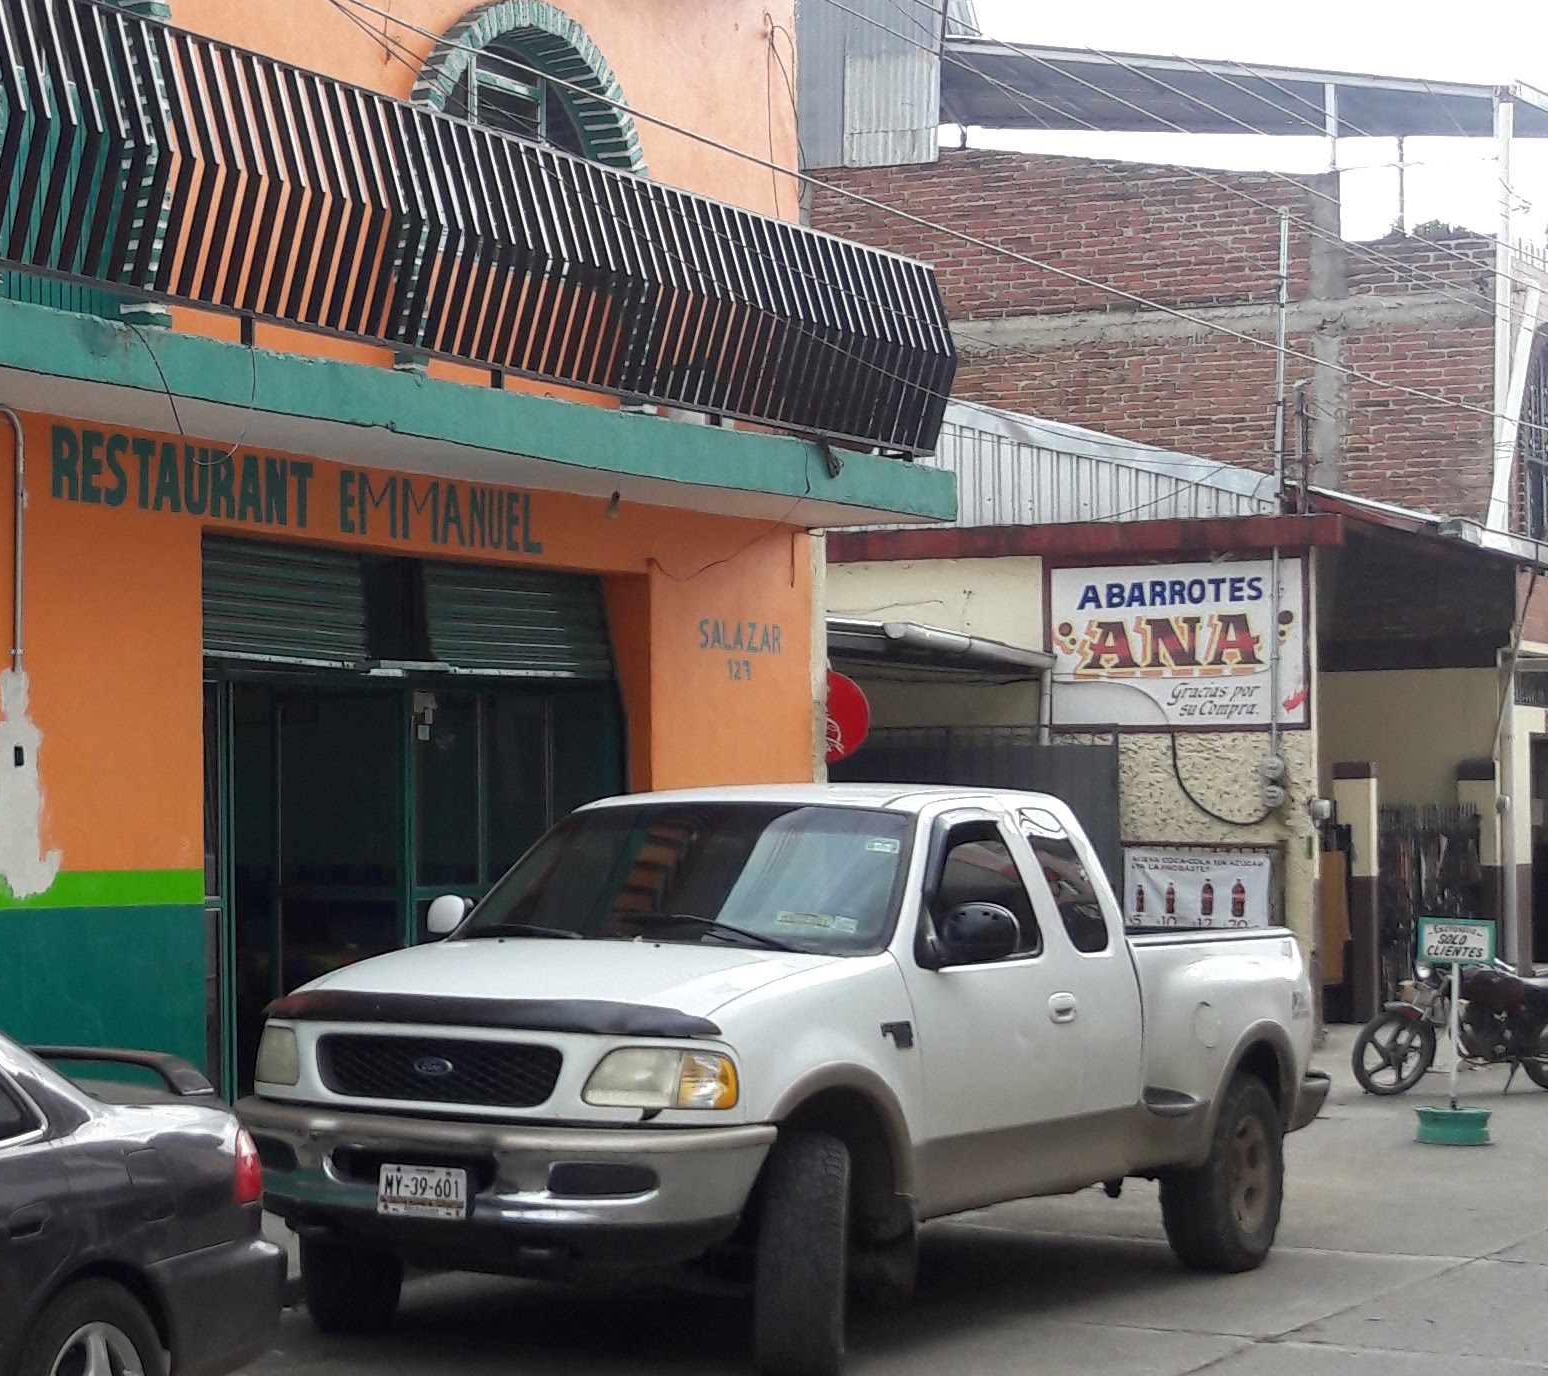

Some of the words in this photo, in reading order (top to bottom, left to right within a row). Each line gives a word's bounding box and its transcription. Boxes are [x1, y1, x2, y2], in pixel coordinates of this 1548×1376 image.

[52, 425, 313, 528] RESTAURANT
[340, 470, 543, 555] EMMANUEL
[1077, 577, 1263, 611] ABARROTES
[699, 618, 782, 655] SALAZAR
[1076, 613, 1266, 679] ANA
[1166, 682, 1228, 706] Gracias
[1229, 686, 1261, 702] por
[1179, 704, 1197, 716] su
[1427, 945, 1483, 958] CLIENTES
[1438, 934, 1468, 945] SOLO
[385, 1174, 459, 1199] MY-39-601
